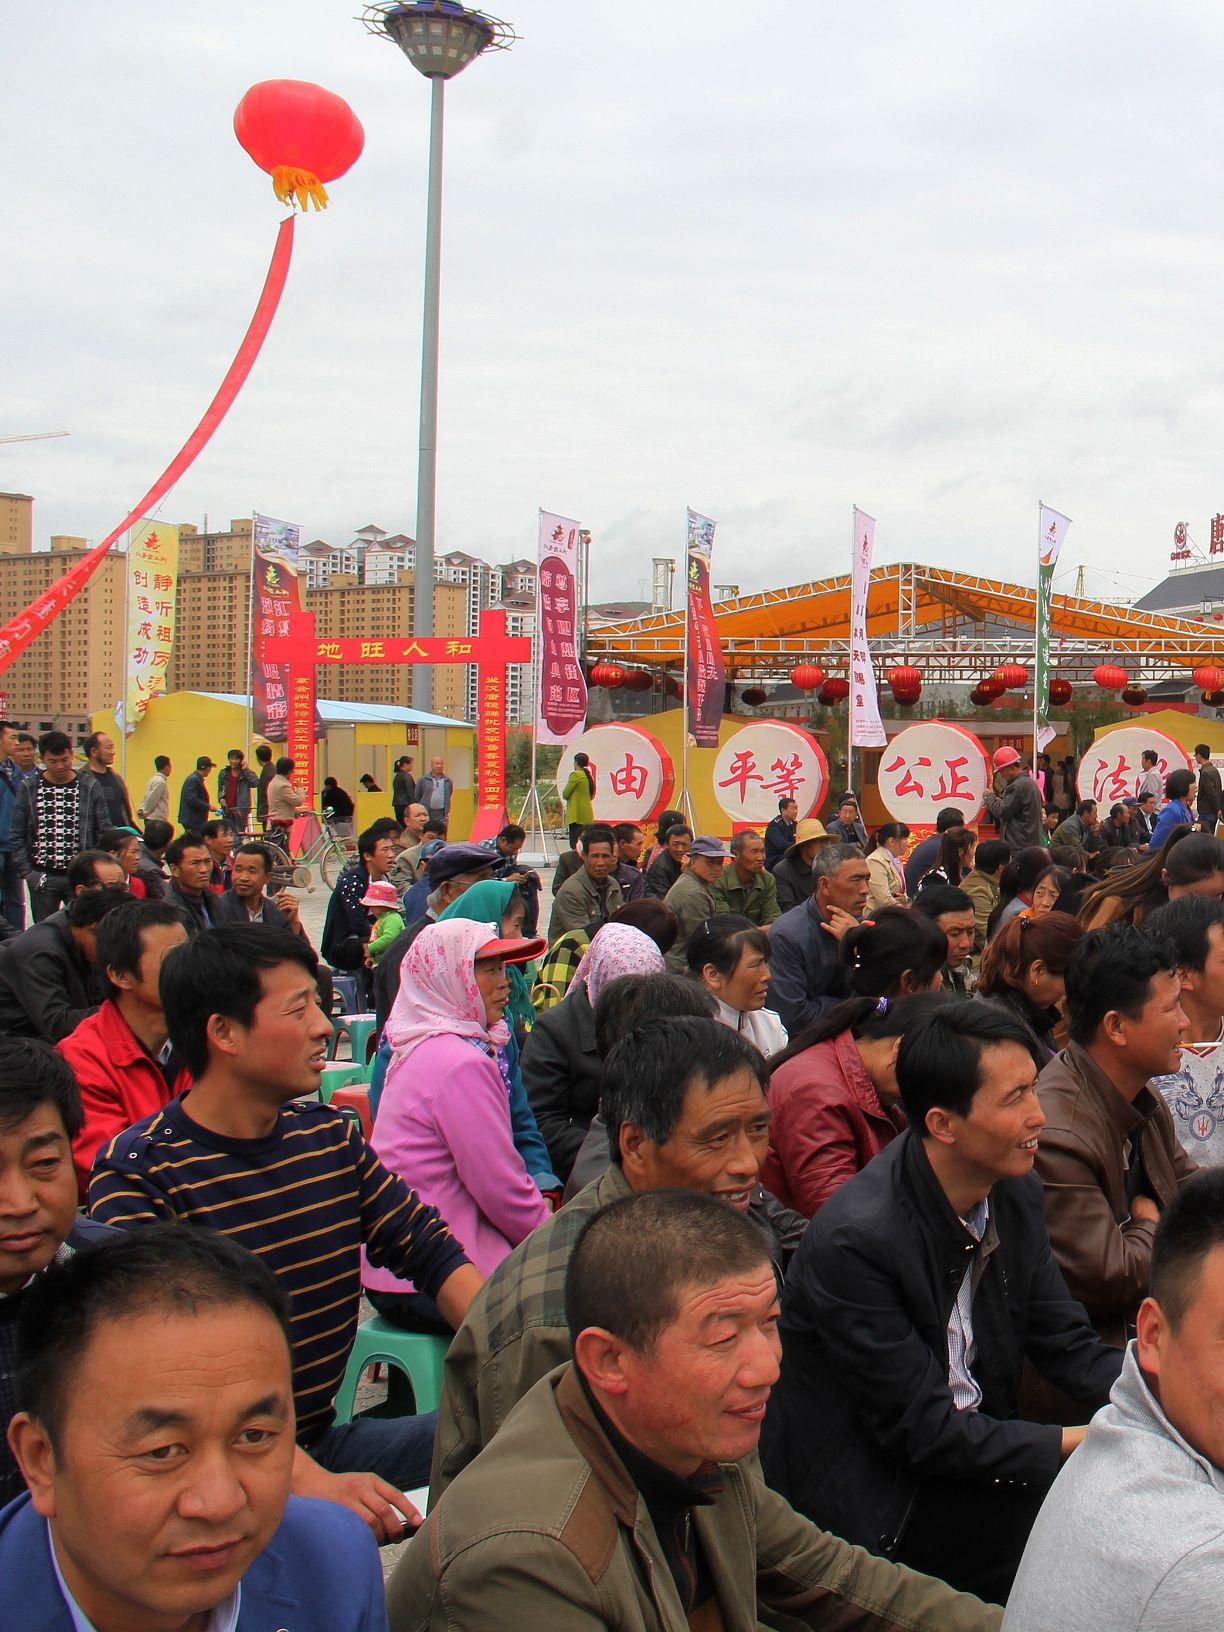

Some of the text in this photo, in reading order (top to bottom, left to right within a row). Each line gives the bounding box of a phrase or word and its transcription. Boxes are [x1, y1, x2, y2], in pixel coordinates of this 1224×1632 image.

[317, 641, 472, 659] 地旺人和
[719, 750, 806, 804] 平等
[884, 756, 975, 801] 公正
[1093, 754, 1171, 804] 法
